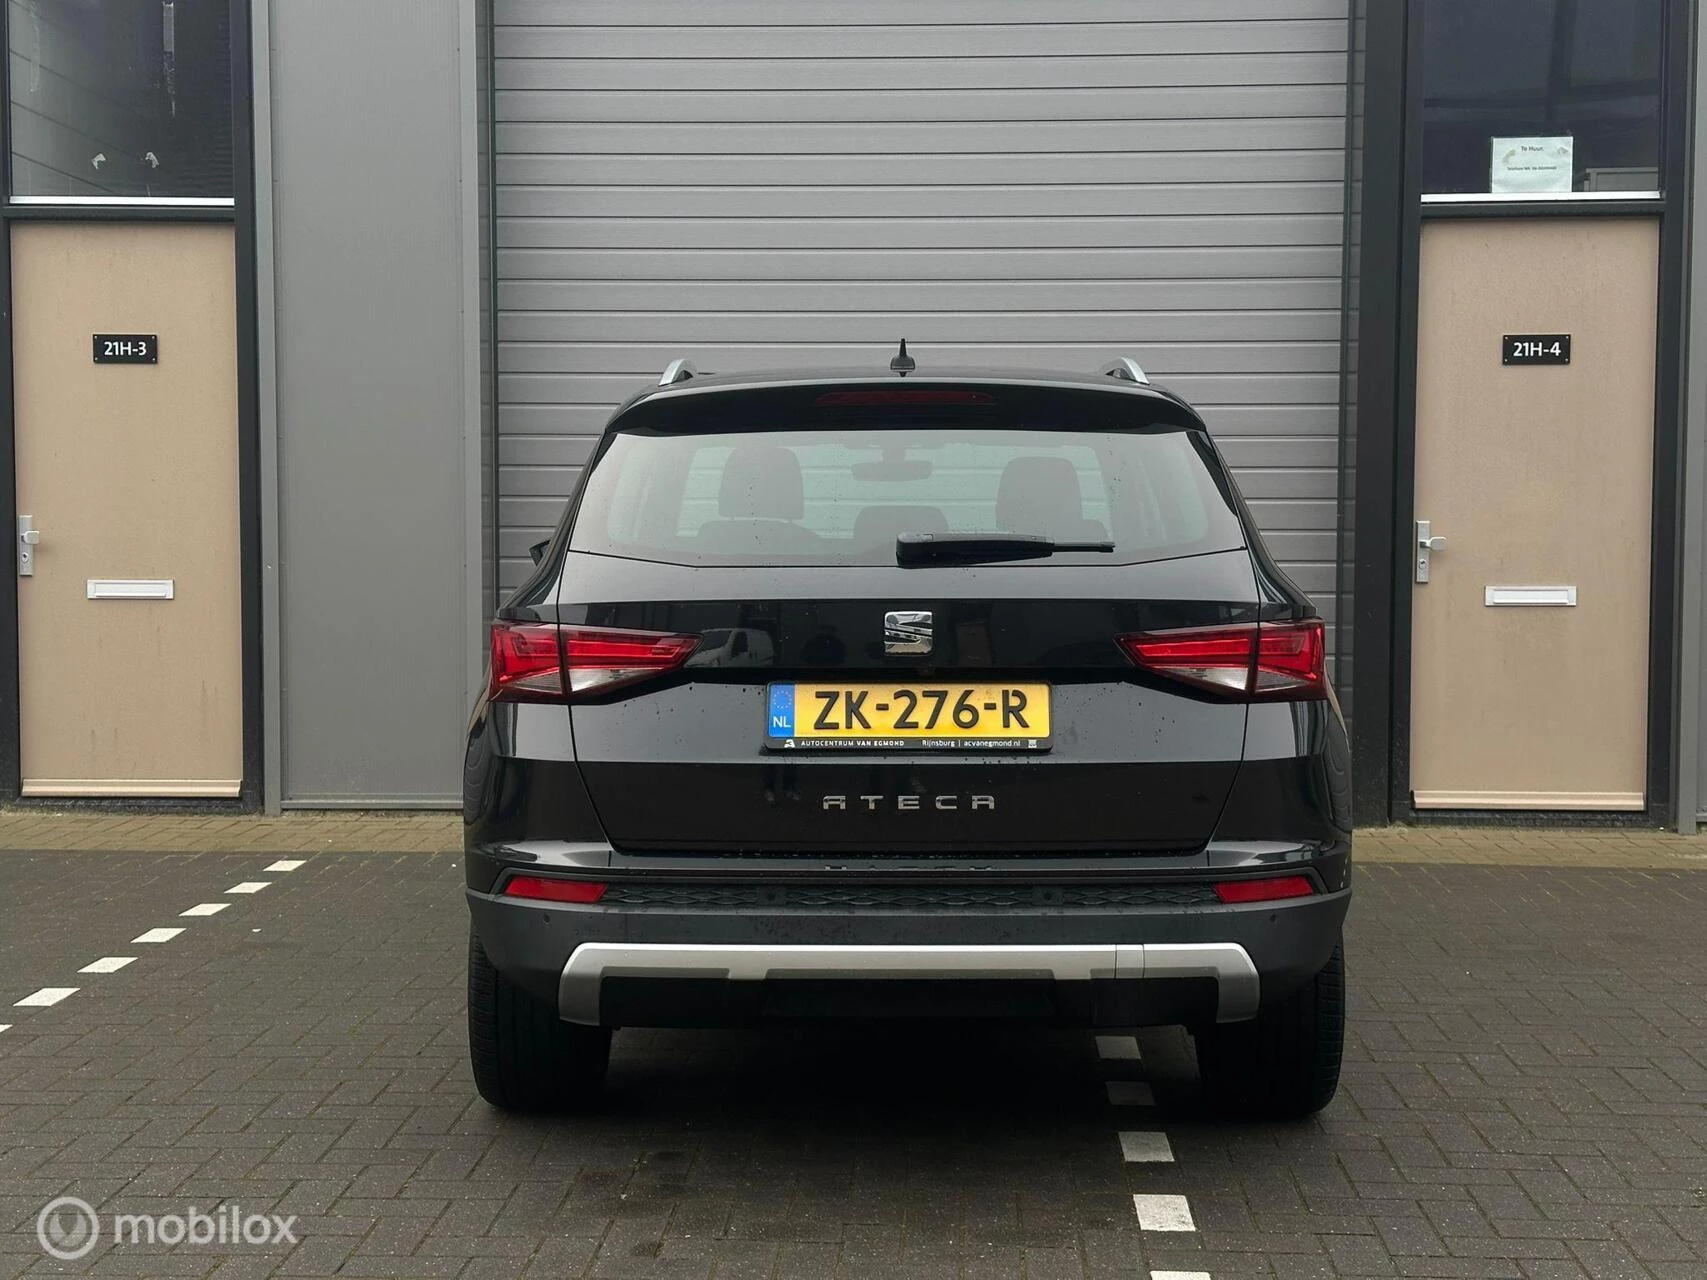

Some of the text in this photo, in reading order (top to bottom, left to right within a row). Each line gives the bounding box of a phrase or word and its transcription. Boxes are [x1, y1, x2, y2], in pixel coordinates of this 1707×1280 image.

[104, 341, 147, 356] 21H-3
[1513, 341, 1562, 357] 21H-4
[813, 689, 1030, 730] ZK-276-R
[773, 716, 791, 728] NL
[922, 740, 956, 748] Rijnsburg
[963, 739, 1021, 748] acvanegmond.nl
[822, 795, 995, 810] ATECA
